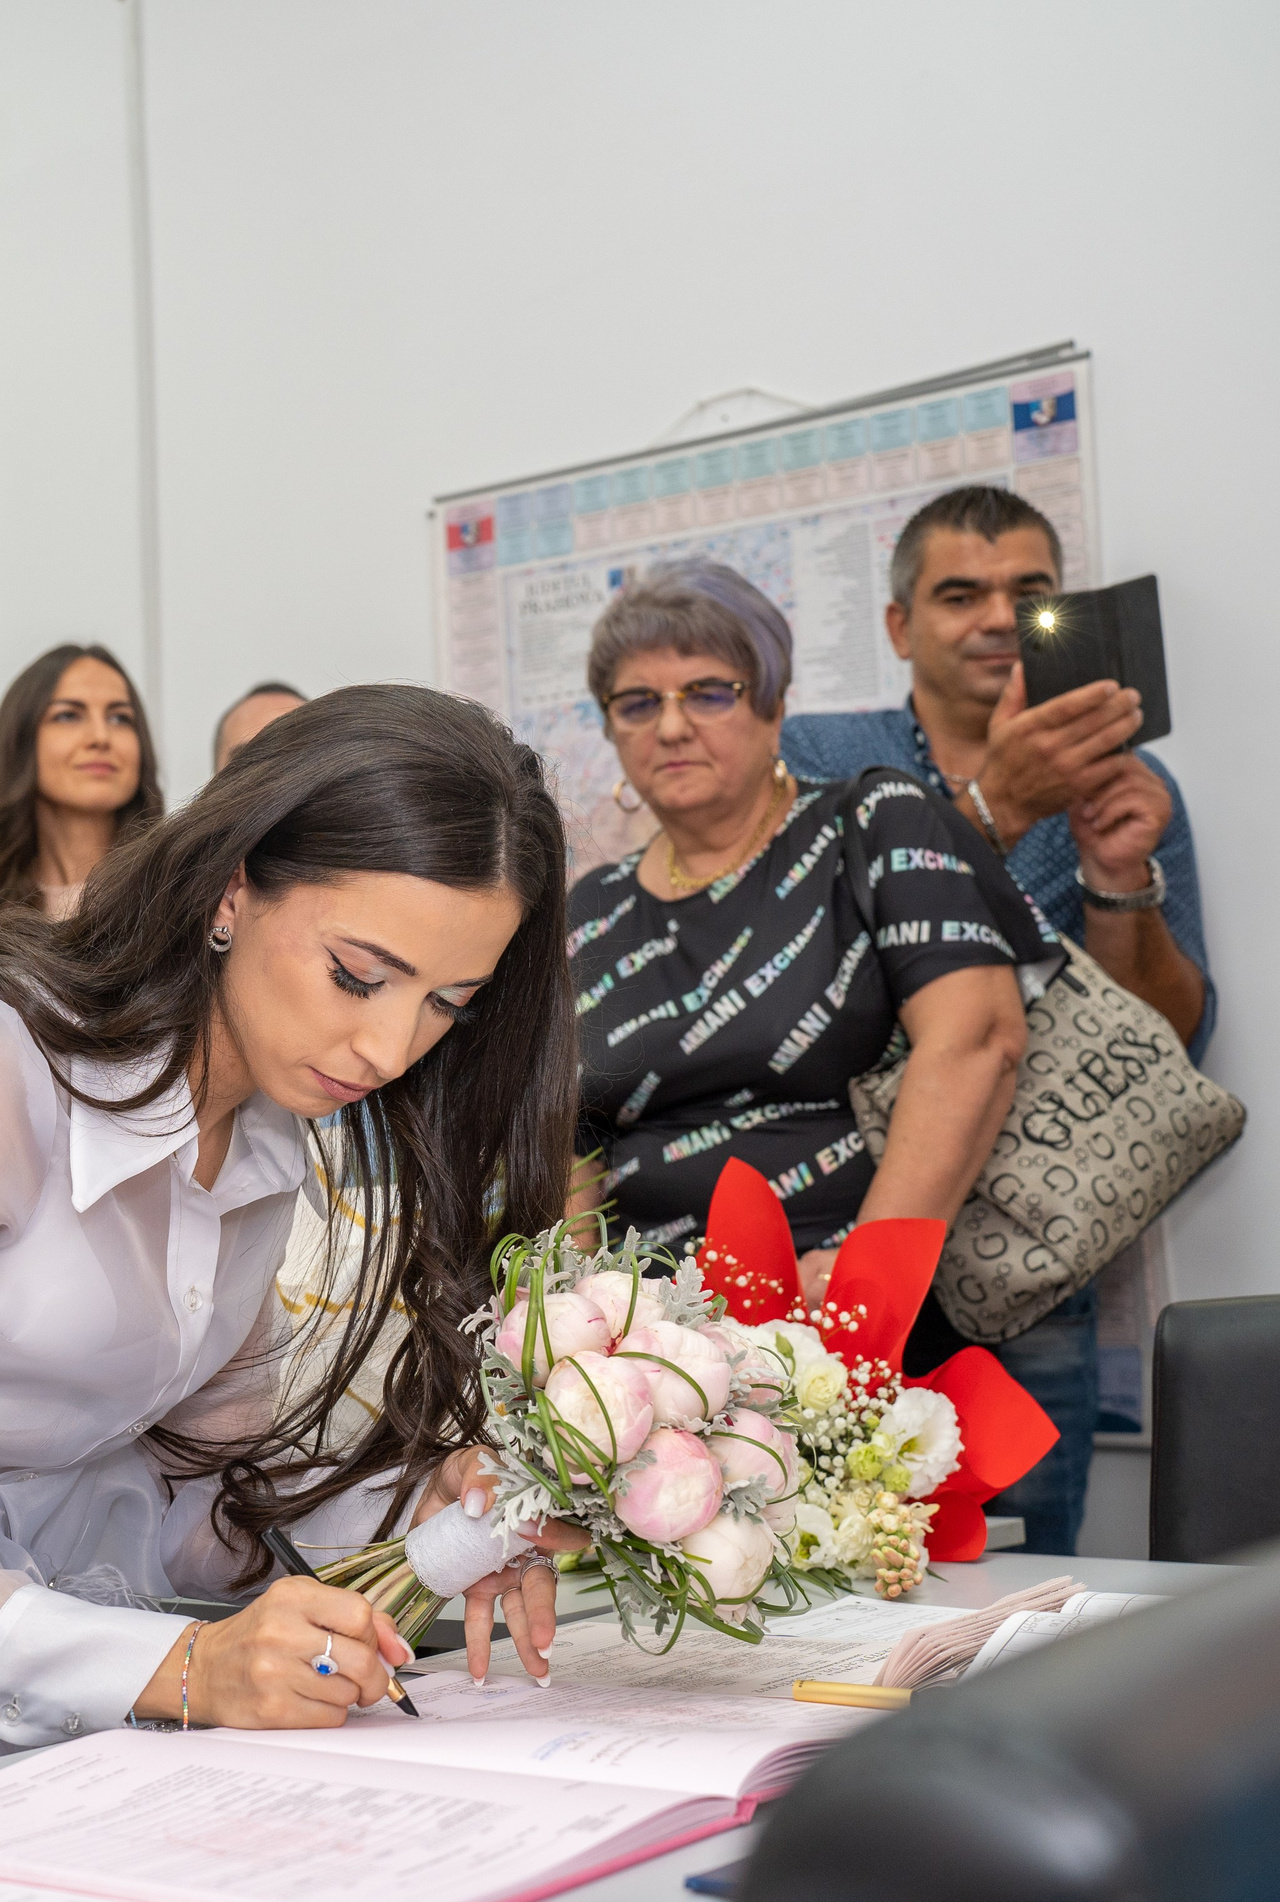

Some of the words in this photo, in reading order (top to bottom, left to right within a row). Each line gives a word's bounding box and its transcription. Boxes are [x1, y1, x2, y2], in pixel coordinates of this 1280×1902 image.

[679, 988, 747, 1055] ARMANI
[768, 1002, 832, 1075] ARMANI
[1022, 1022, 1161, 1147] GUESS
